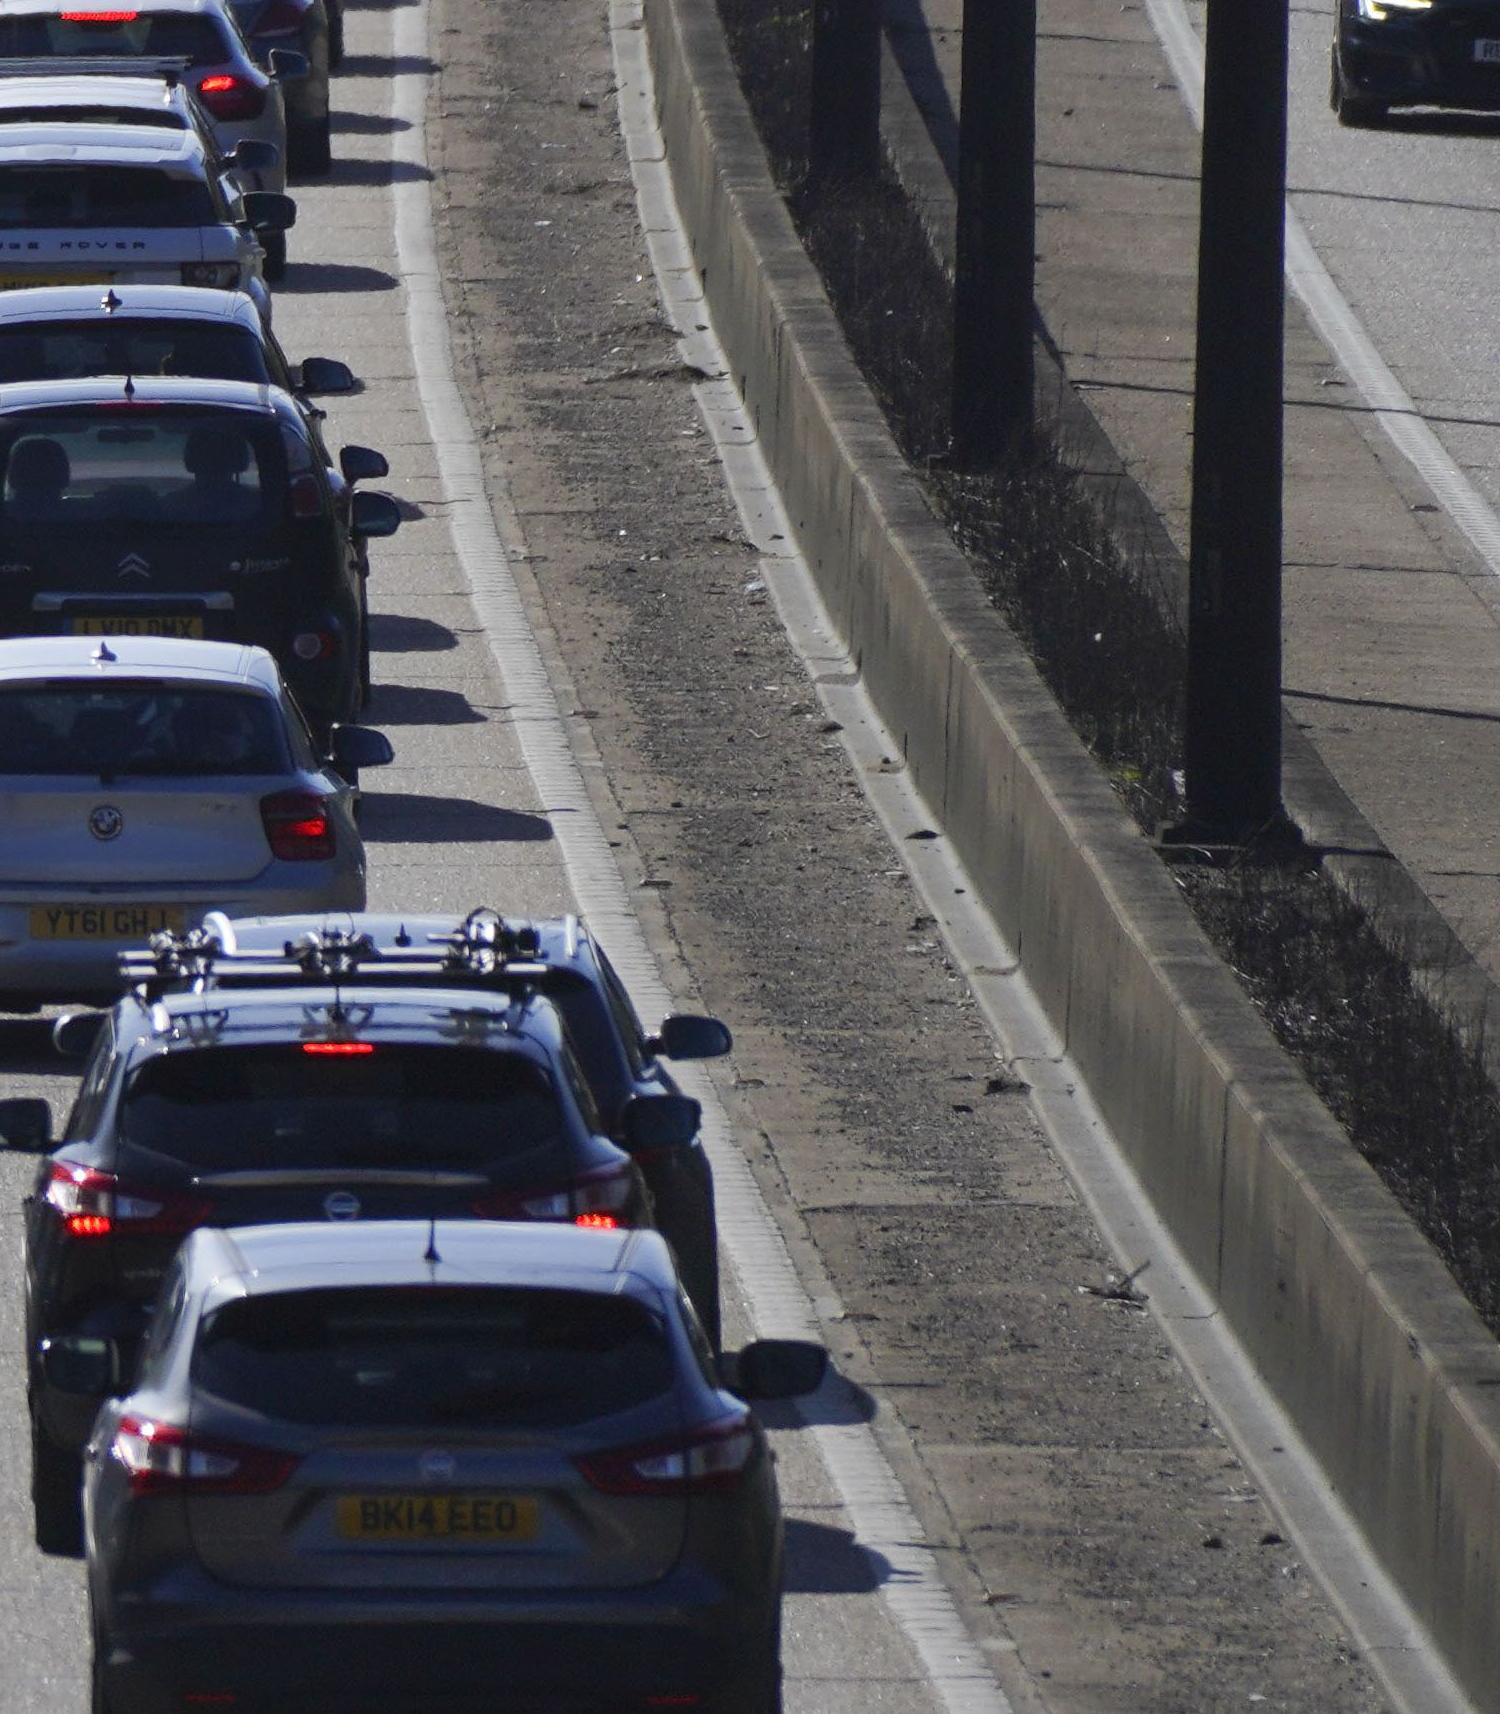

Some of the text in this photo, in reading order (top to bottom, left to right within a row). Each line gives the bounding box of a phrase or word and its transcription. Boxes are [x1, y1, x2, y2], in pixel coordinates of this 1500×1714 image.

[46, 909, 105, 935] YT61
[359, 1500, 517, 1531] BK14 EEO
